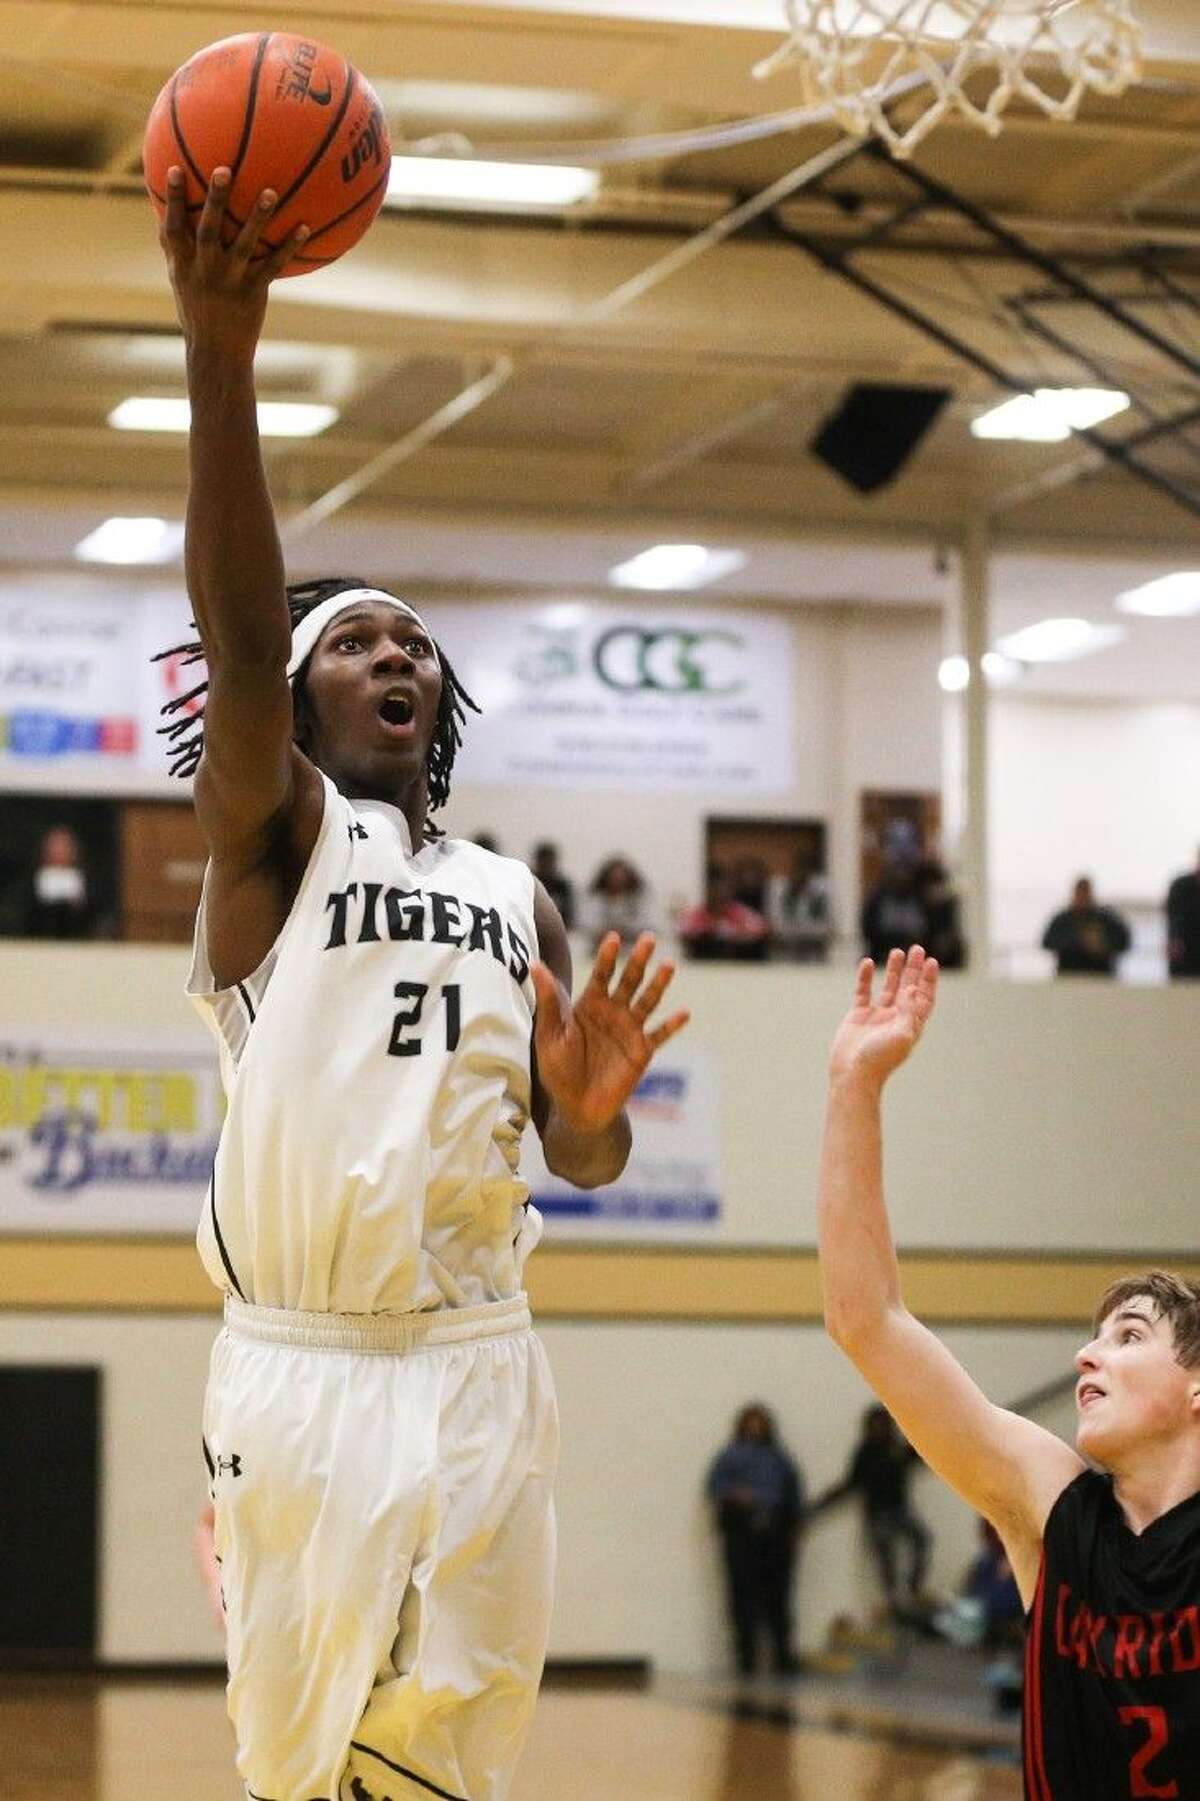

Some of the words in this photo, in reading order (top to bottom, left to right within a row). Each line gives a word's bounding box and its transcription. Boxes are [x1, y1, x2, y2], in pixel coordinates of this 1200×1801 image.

[324, 883, 530, 985] TIGERS
[387, 982, 461, 1056] 21
[1118, 1705, 1179, 1798] 2
